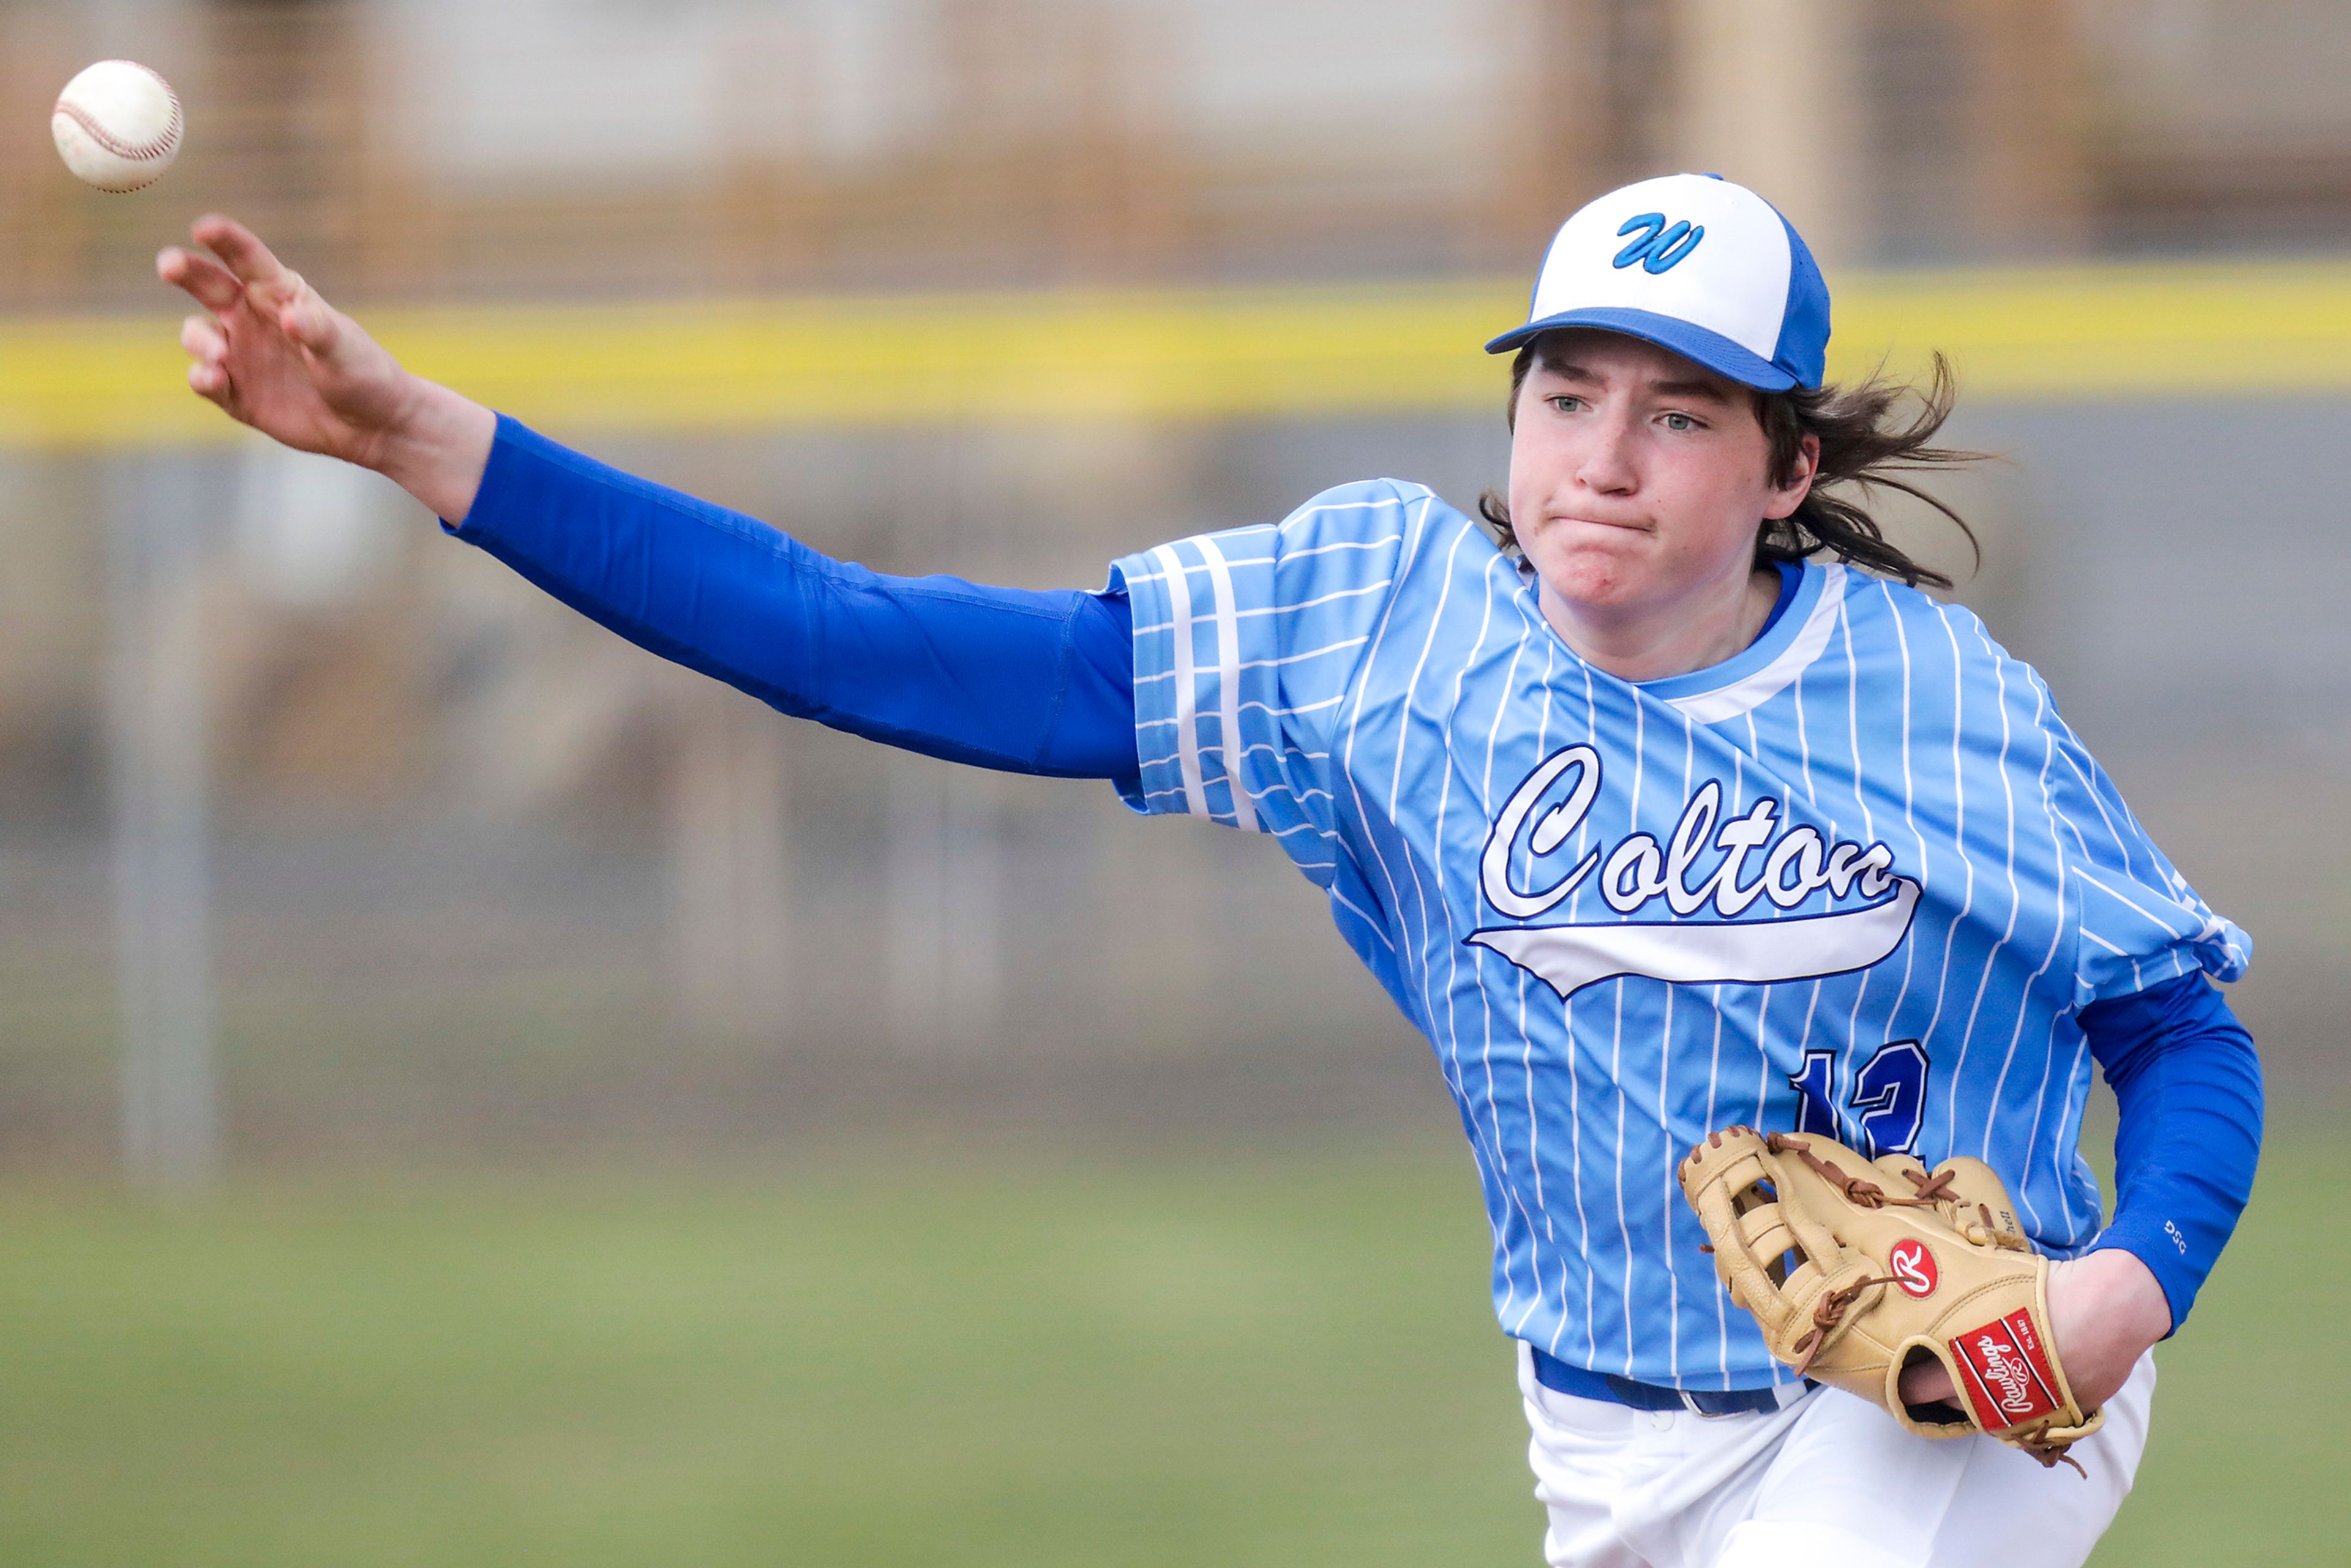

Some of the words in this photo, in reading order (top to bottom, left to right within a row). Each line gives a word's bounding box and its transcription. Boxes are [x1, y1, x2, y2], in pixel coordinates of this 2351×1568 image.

[1613, 212, 1704, 275] W
[1478, 743, 1899, 919] Colton
[1787, 1038, 1931, 1168] 12
[1893, 1245, 1930, 1292] R
[2164, 1220, 2187, 1255] DSG
[1977, 1335, 2033, 1412] Rawlings
